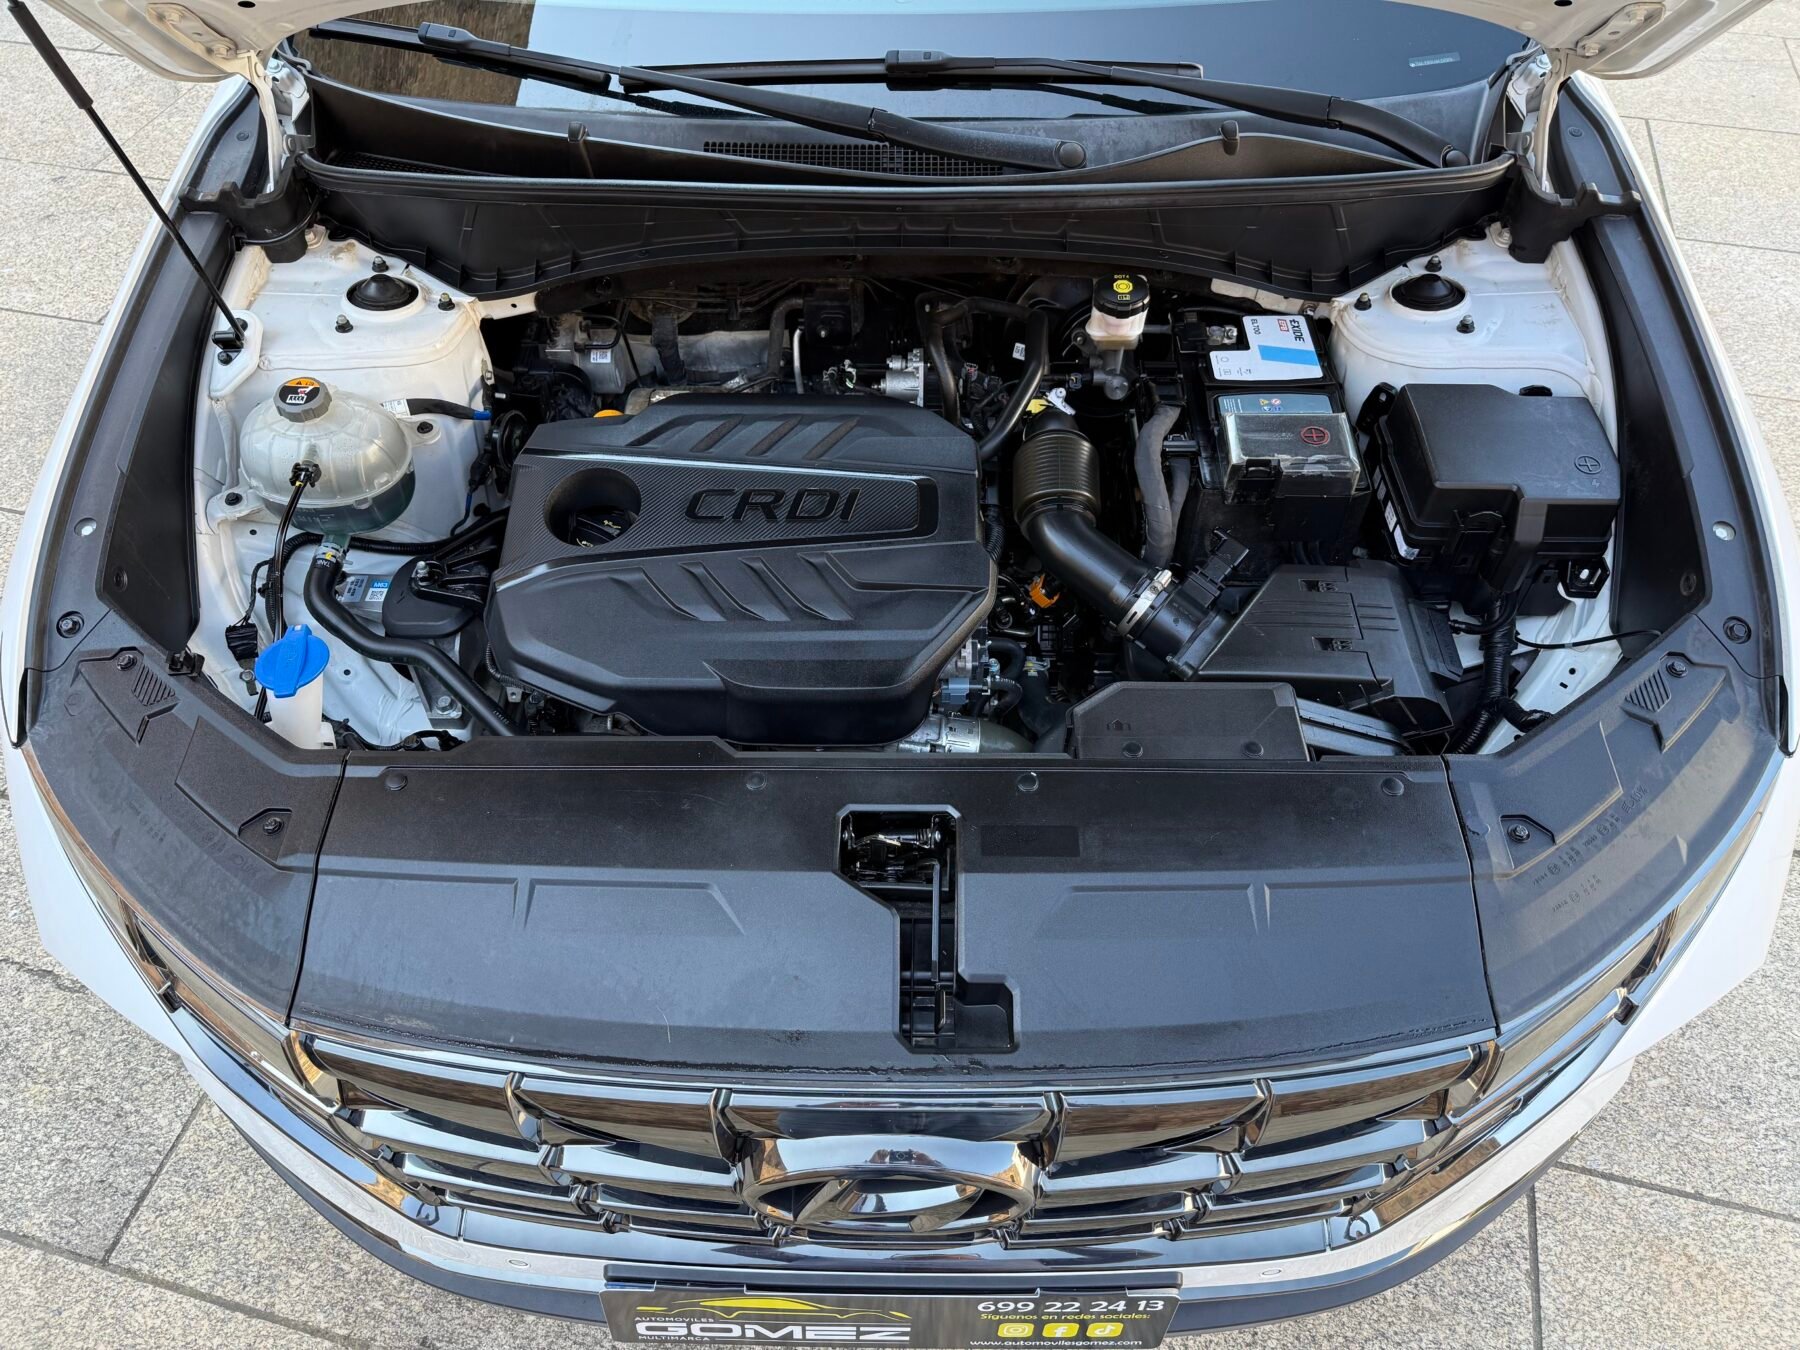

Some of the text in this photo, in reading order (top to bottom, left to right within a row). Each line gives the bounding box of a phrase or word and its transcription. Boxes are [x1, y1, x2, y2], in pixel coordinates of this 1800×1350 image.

[1251, 318, 1261, 335] EL700
[1289, 318, 1305, 343] EXIDE
[684, 487, 862, 522] CRDI
[977, 1300, 1165, 1312] 699 22 24 13
[635, 1322, 911, 1341] GOMEZ
